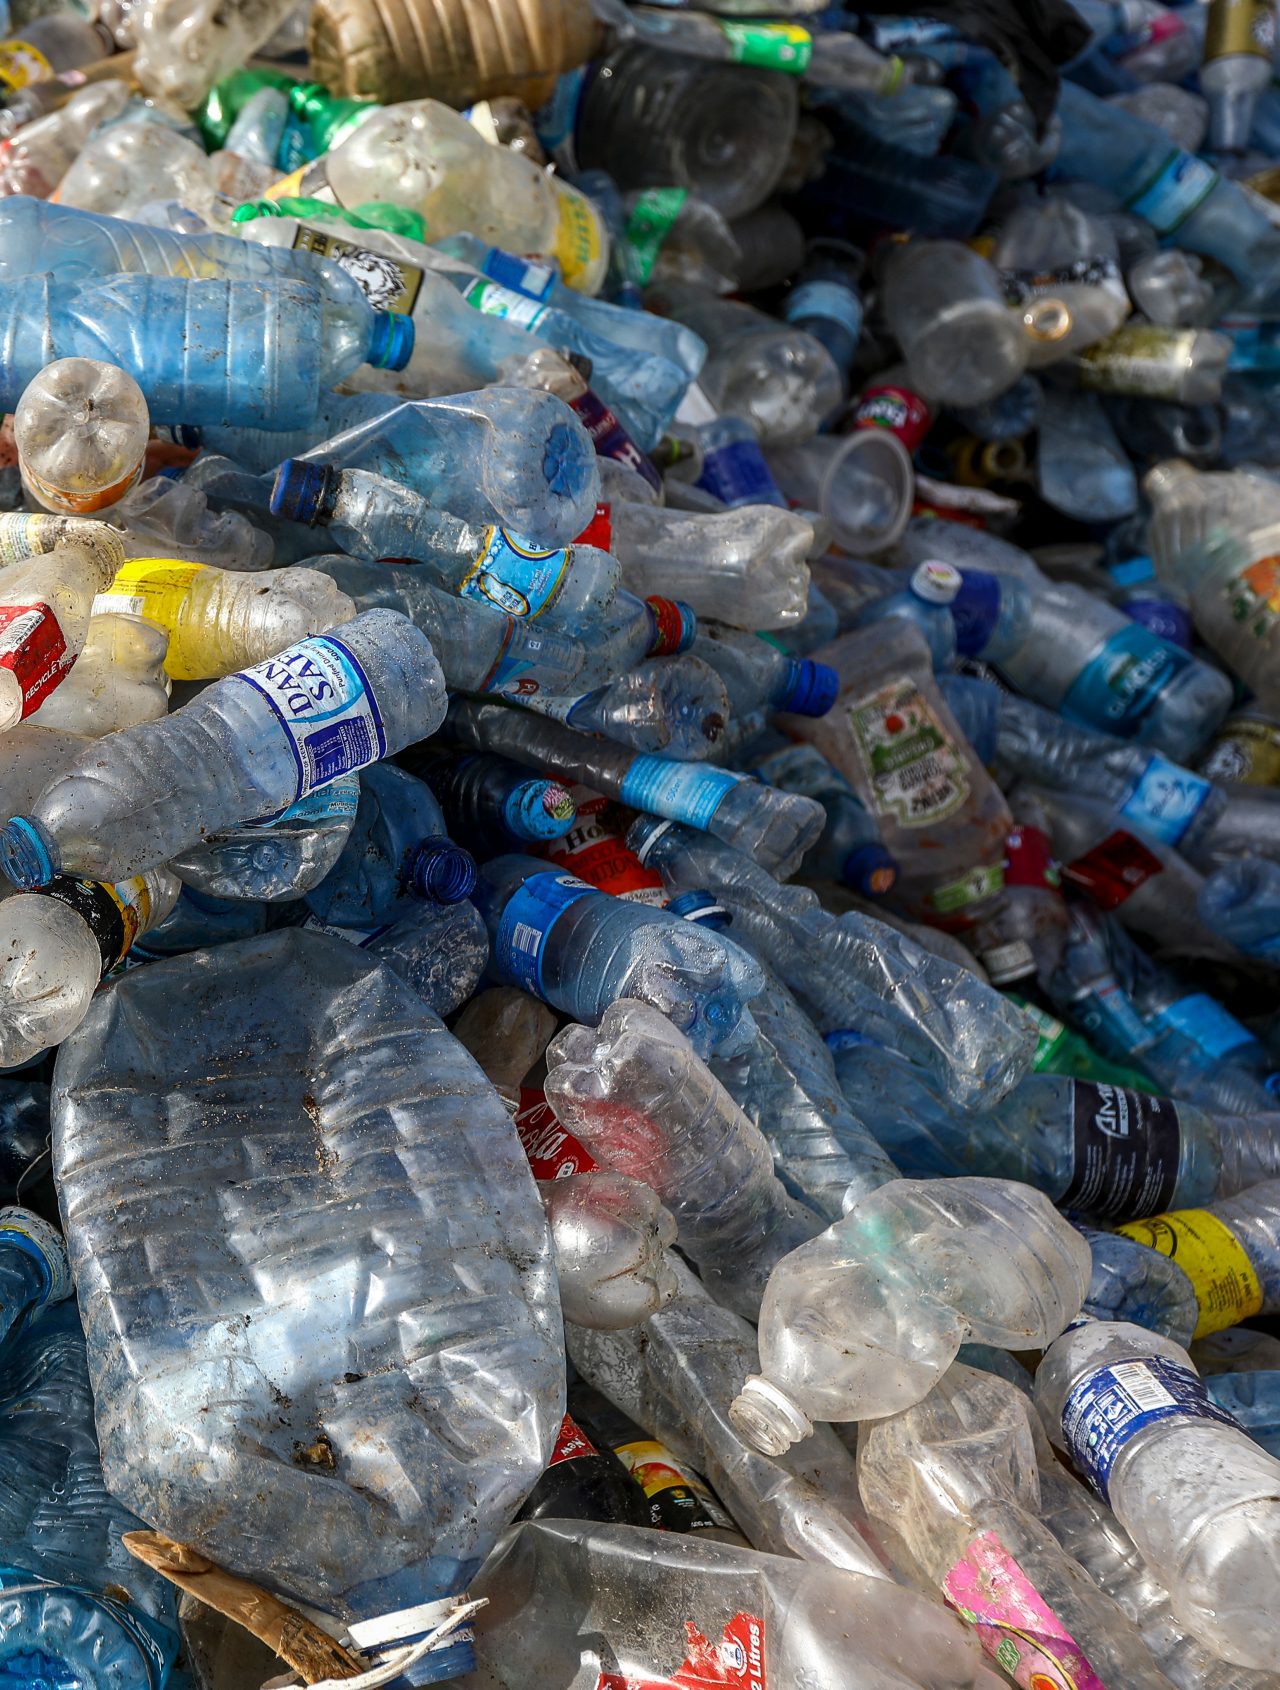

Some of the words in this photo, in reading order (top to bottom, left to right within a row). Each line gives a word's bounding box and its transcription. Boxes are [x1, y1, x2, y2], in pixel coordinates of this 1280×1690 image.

[25, 660, 58, 702] RECYCLE
[297, 736, 307, 760] KENYA
[561, 1437, 586, 1457] New
[749, 1623, 762, 1678] Litres
